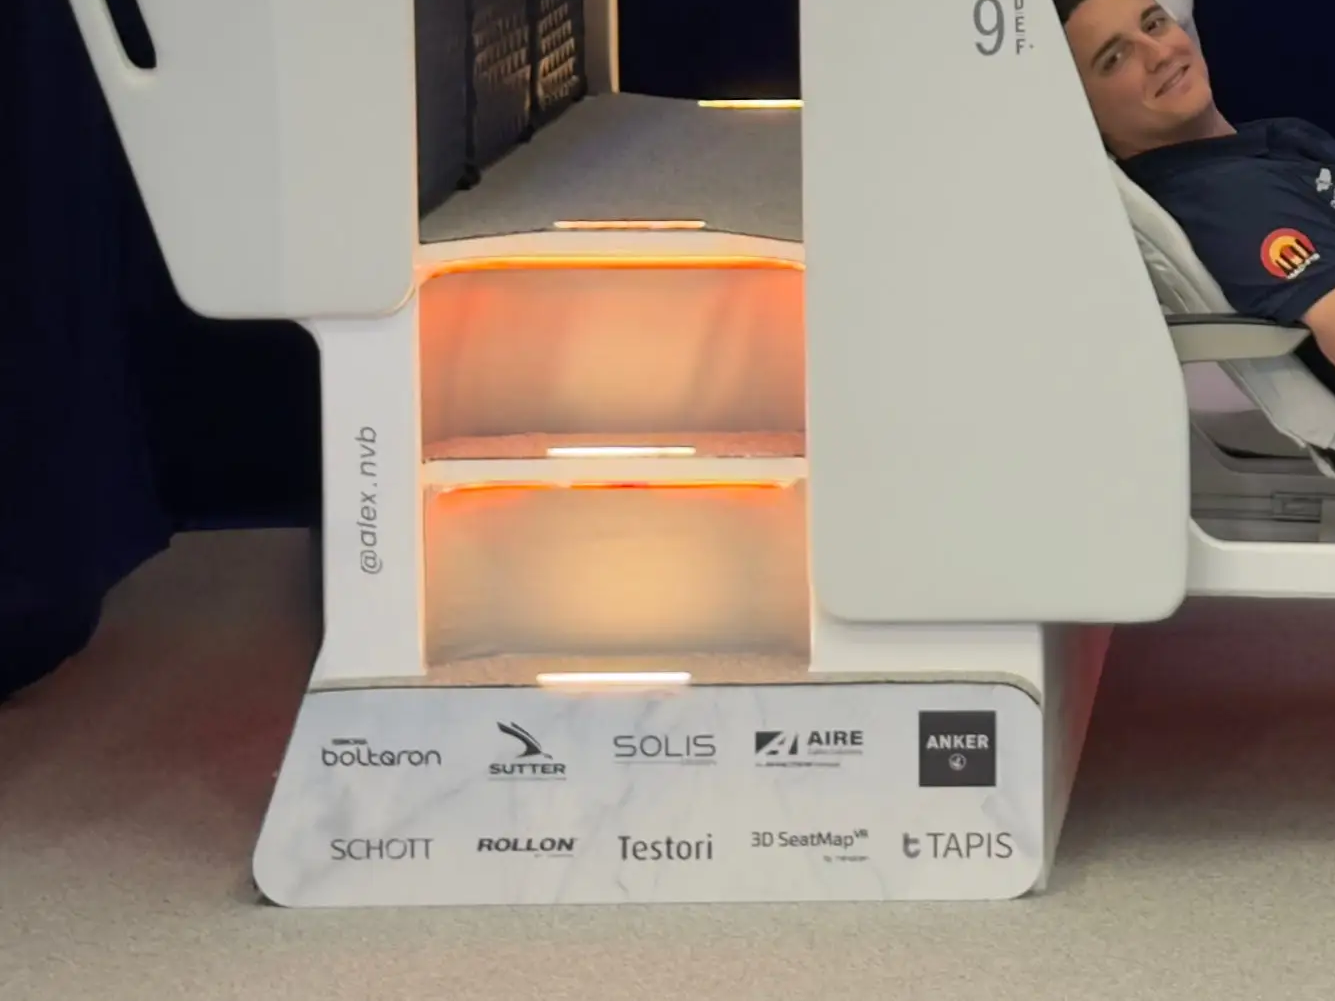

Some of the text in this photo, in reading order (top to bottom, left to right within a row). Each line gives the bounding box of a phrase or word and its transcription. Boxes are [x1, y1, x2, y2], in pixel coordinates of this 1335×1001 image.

[354, 425, 383, 575] @alex.nvb
[613, 735, 717, 757] SOLIS
[807, 730, 864, 746] AIRE
[926, 734, 989, 750] ANKER
[322, 747, 442, 767] boltaron
[489, 763, 566, 775] SUTTER
[476, 837, 575, 852] ROLLON
[618, 833, 713, 861] Testori
[751, 831, 774, 848] 3D
[330, 838, 434, 860] SCHOTT
